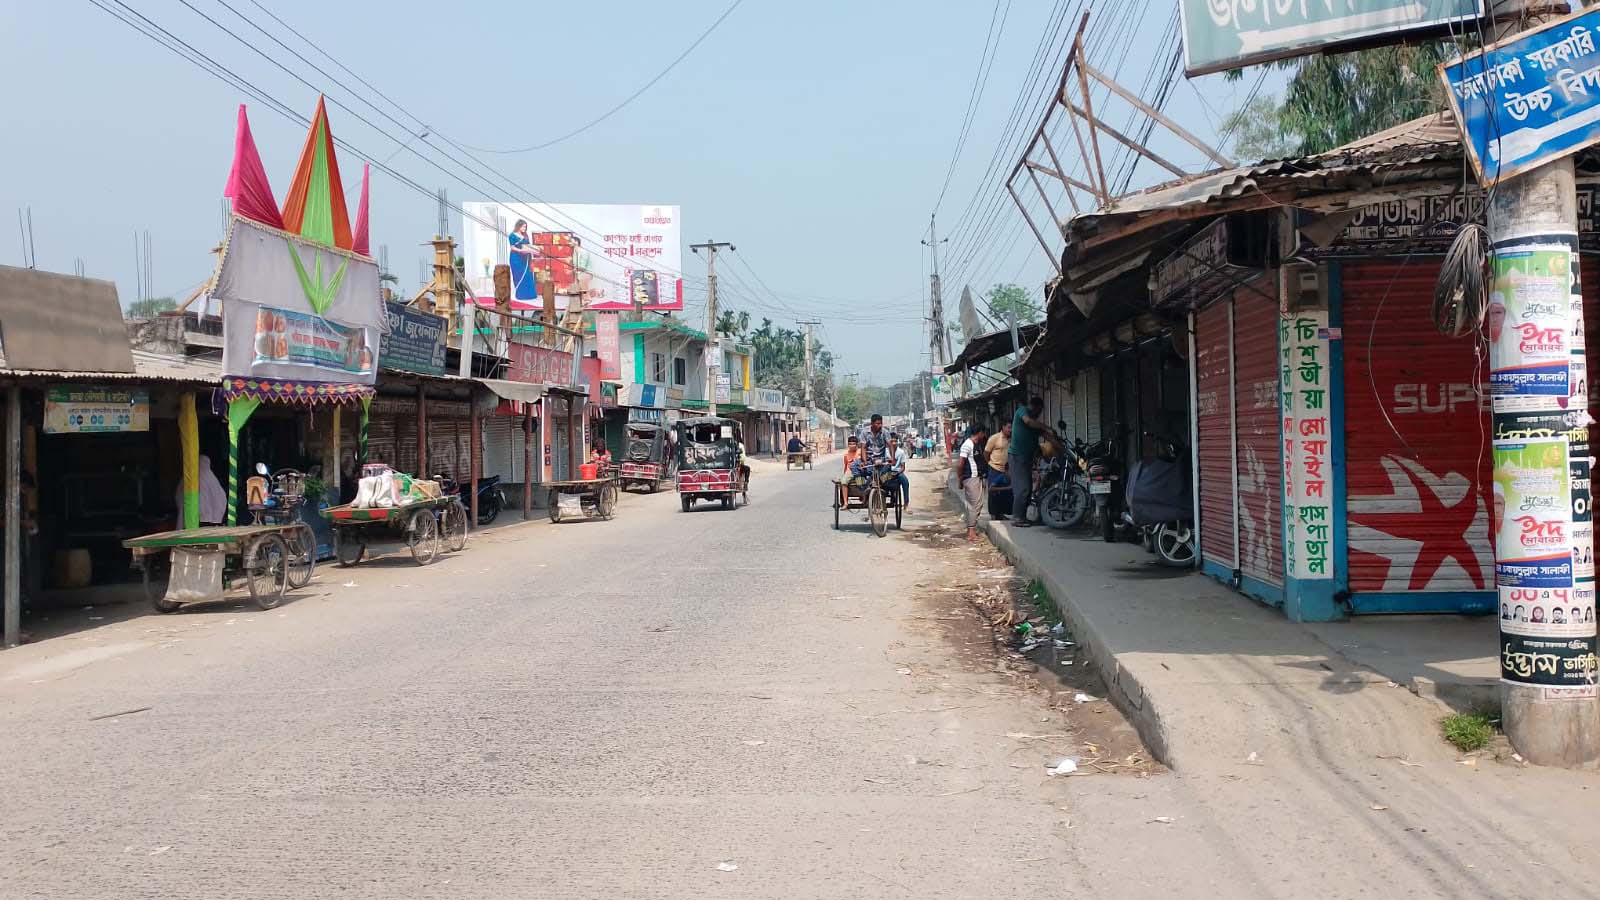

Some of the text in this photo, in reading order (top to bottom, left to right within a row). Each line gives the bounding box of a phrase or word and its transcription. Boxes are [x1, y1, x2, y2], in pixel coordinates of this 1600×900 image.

[1525, 26, 1595, 71] সরকারি
[1504, 85, 1552, 121] উচ্চ
[1513, 322, 1565, 344] ঈদ
[1393, 382, 1496, 414] SUPE
[1294, 317, 1329, 575] চিশতীয়া মোবাইল হাসপাতাল
[1512, 515, 1565, 537] ঈদ
[1502, 642, 1561, 677] উদ্ভাস
